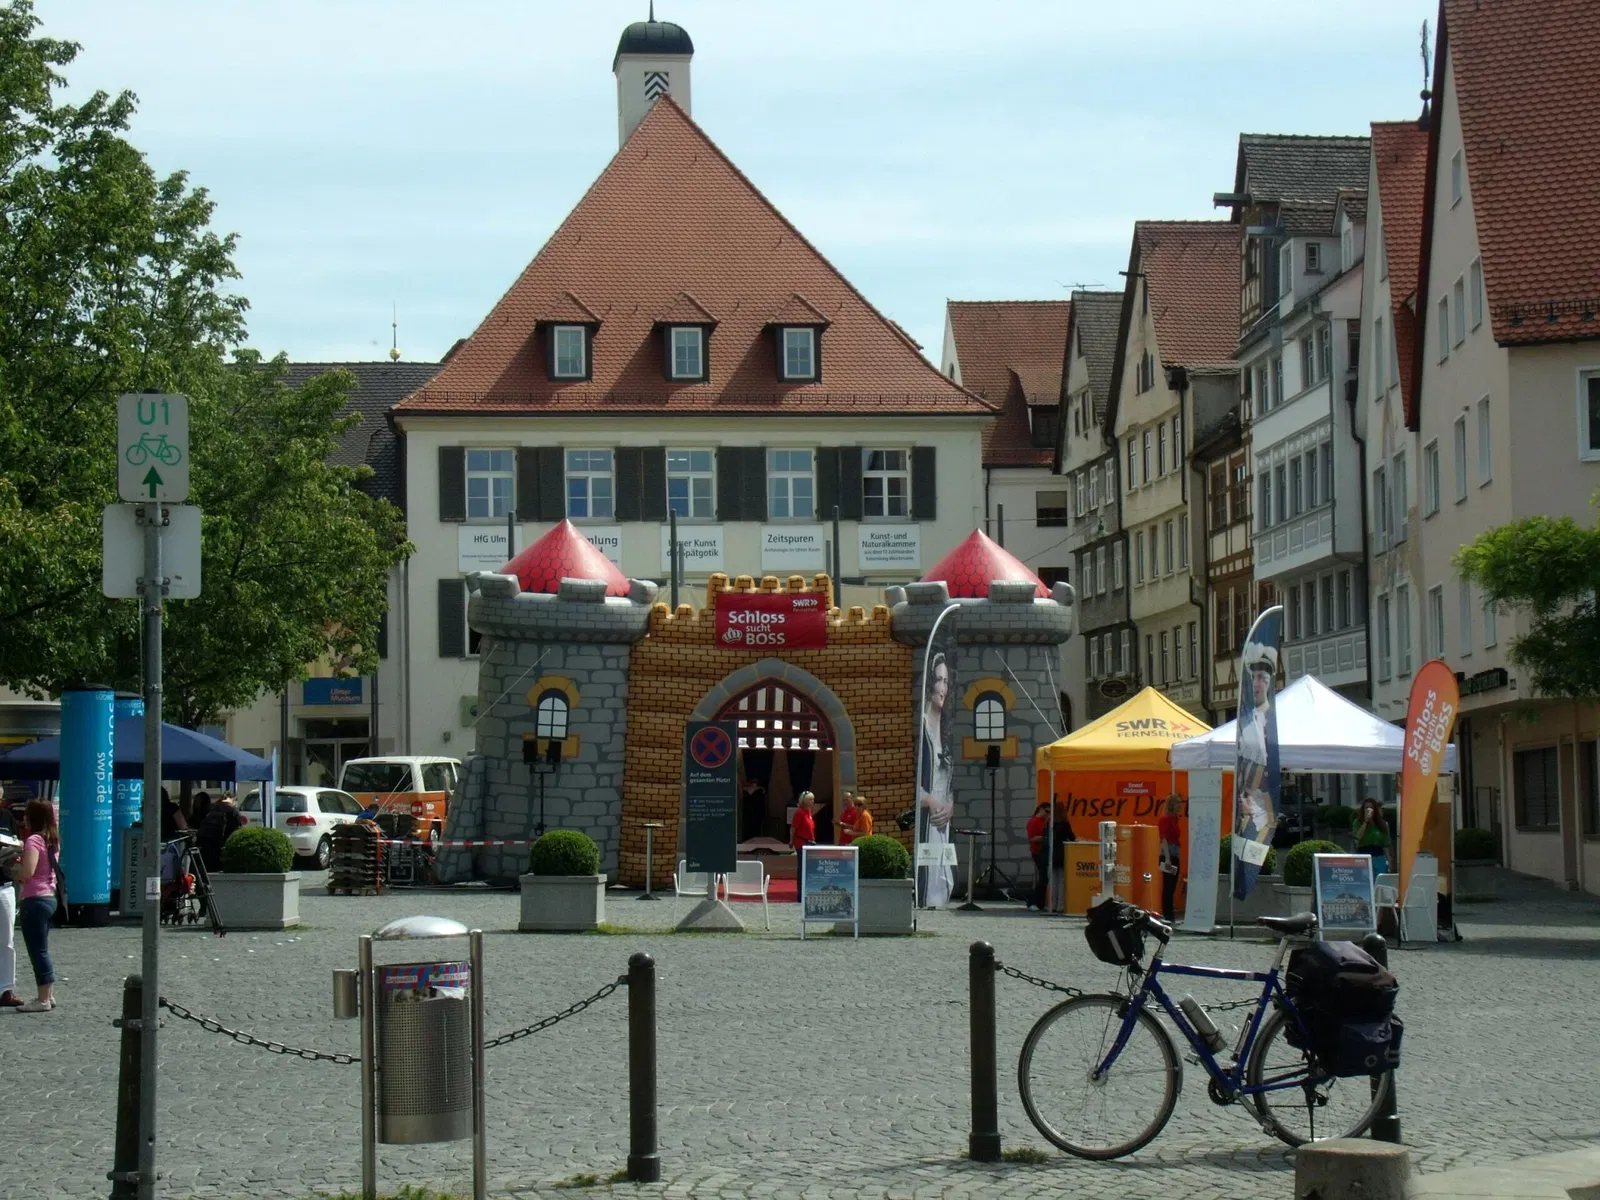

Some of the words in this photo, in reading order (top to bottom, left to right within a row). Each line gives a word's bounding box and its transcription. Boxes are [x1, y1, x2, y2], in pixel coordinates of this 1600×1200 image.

[137, 401, 169, 426] U1
[474, 535, 489, 543] HfG
[491, 535, 507, 543] Ulm
[768, 534, 814, 545] Zeitspuren
[894, 532, 908, 540] und
[694, 539, 717, 547] Kunst
[862, 540, 917, 548] Naturalkammer
[792, 599, 810, 607] SWR
[728, 610, 786, 624] Schloss
[746, 624, 771, 632] sucht
[746, 632, 786, 645] BOSS
[1116, 717, 1168, 732] SWR
[1408, 689, 1437, 762] Schloss
[1425, 713, 1439, 746] sucht
[1430, 702, 1453, 753] BOSS
[1117, 730, 1194, 738] FERNSEHEN
[94, 751, 108, 803] swp.de
[1053, 793, 1128, 818] Unser
[1076, 861, 1096, 871] SWR
